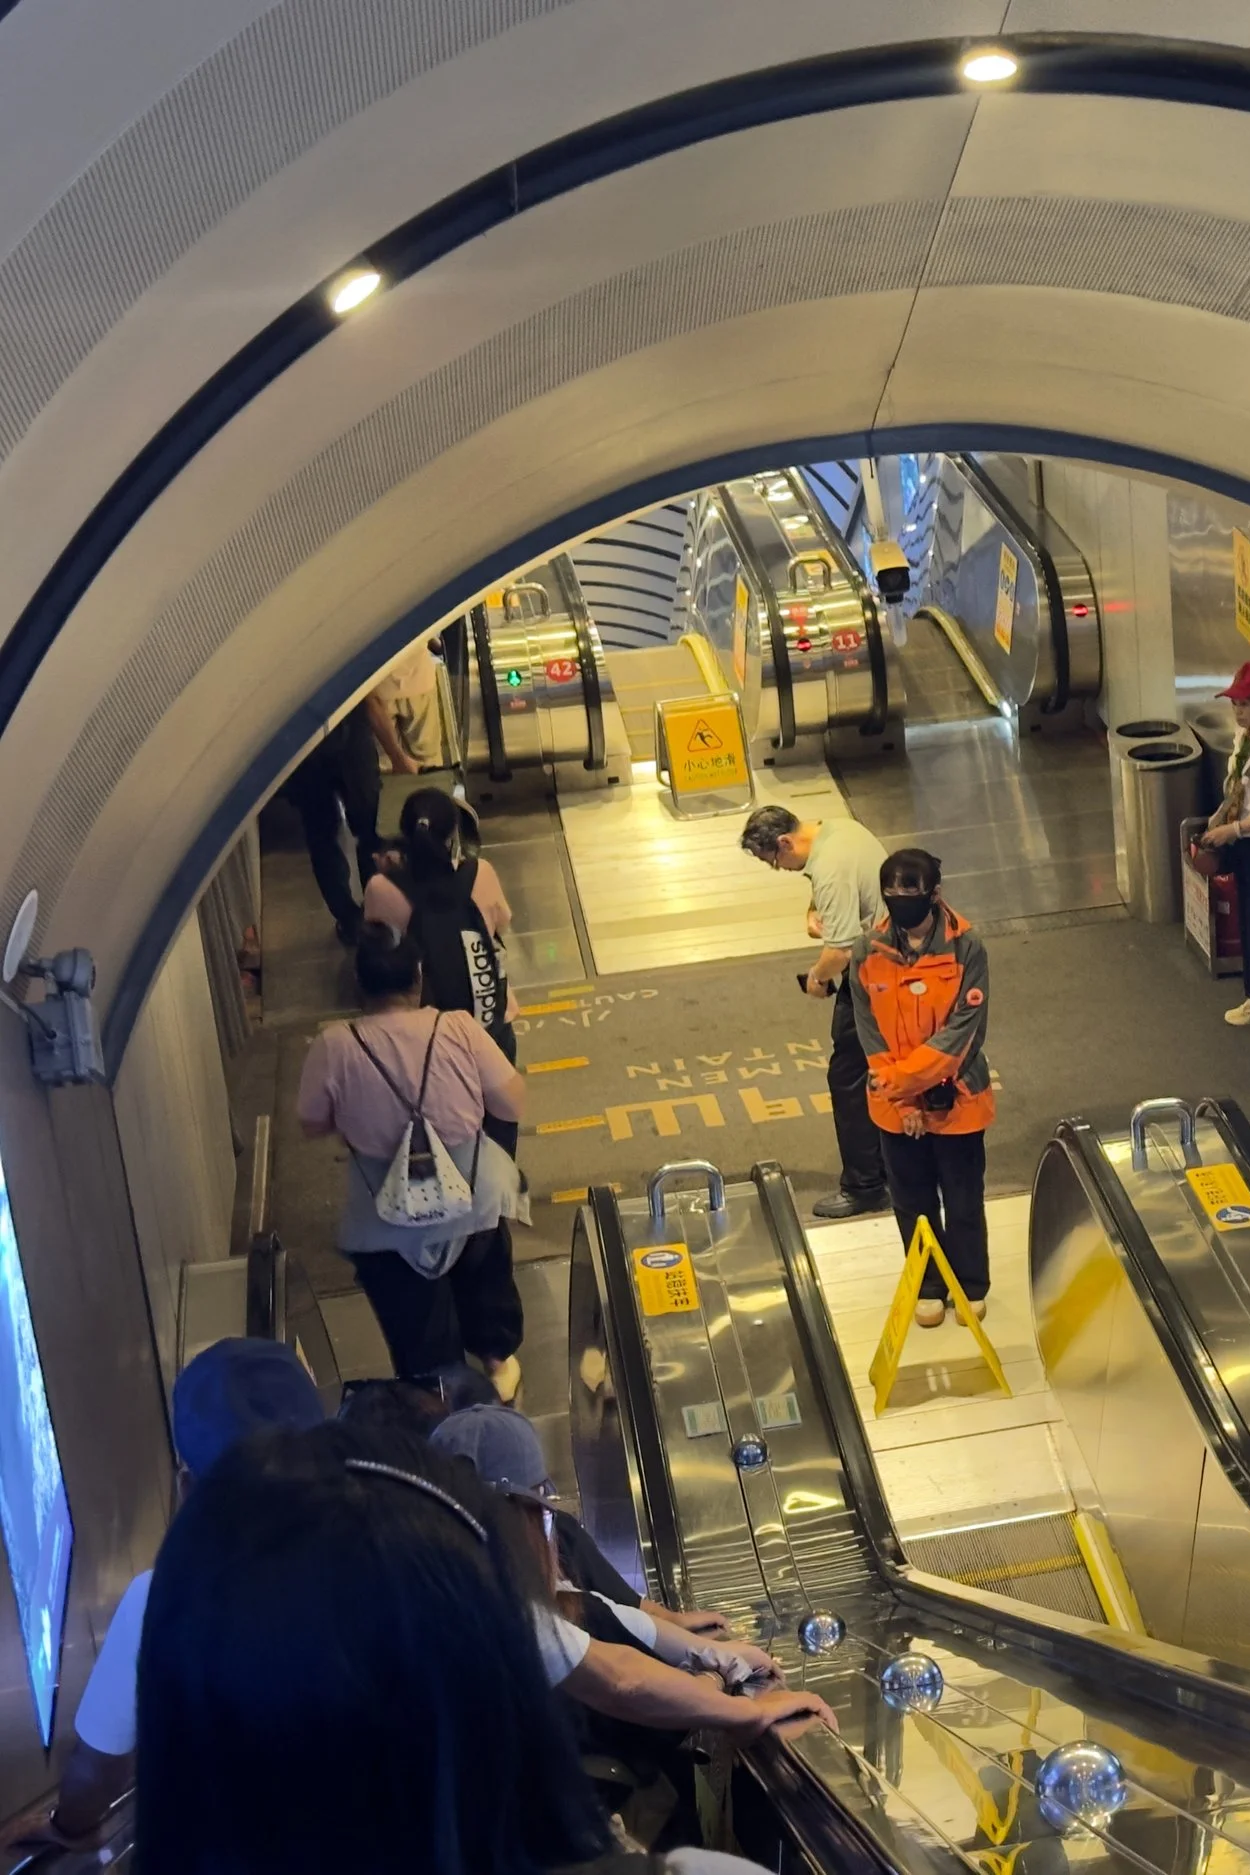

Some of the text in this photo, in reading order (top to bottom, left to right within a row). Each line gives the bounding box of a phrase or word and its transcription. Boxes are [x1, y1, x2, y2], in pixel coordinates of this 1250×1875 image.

[835, 633, 858, 650] 11
[550, 661, 573, 677] 42
[470, 940, 496, 1023] adidas
[626, 1038, 824, 1079] NTAIN
